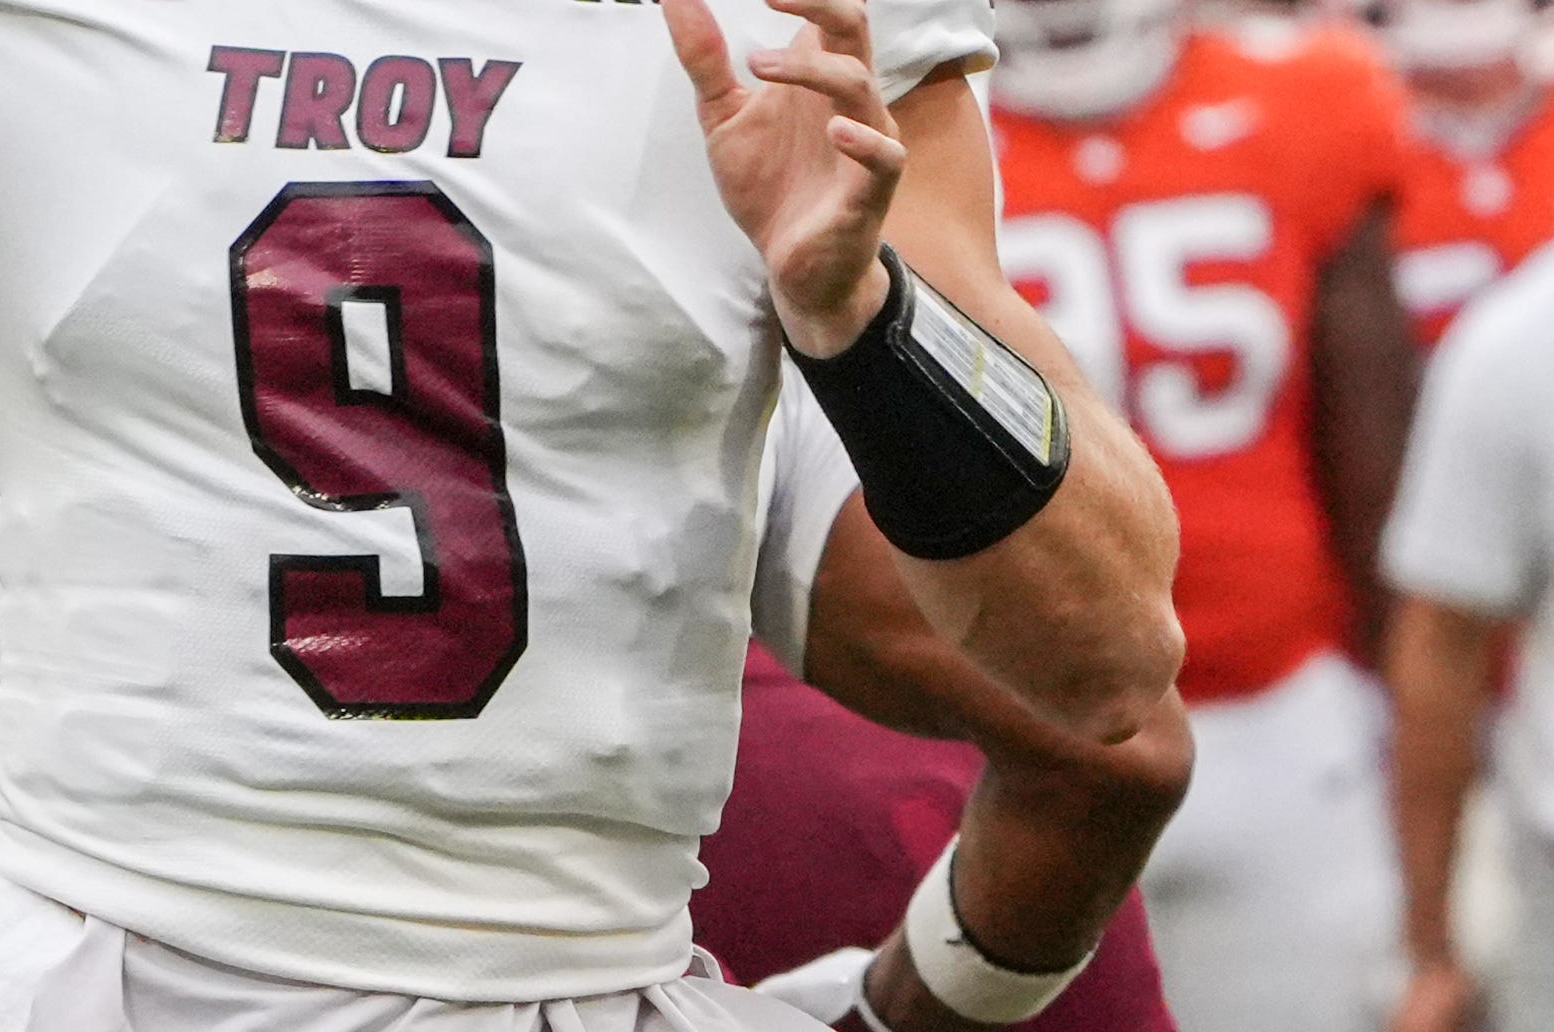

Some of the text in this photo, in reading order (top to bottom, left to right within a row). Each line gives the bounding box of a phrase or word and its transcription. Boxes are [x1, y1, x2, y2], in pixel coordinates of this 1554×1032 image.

[206, 44, 523, 159] TROY
[229, 180, 528, 720] 9
[1001, 194, 1292, 456] 95
